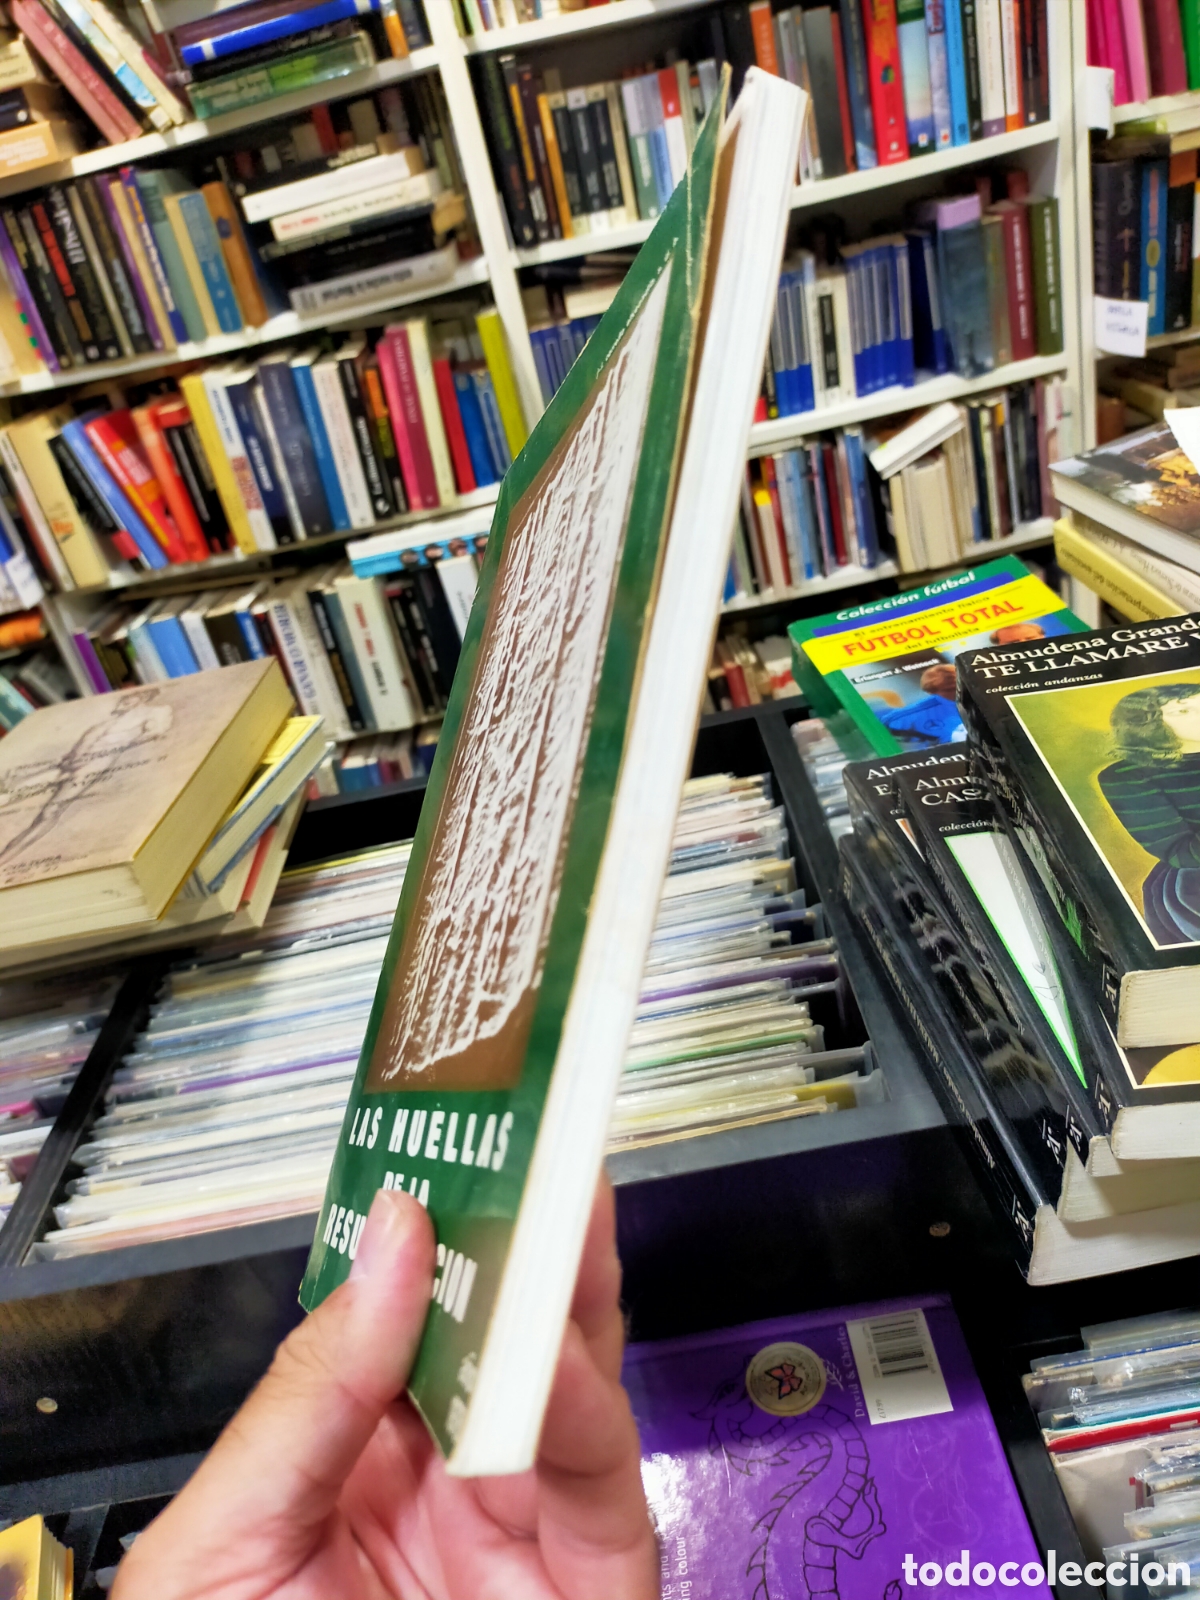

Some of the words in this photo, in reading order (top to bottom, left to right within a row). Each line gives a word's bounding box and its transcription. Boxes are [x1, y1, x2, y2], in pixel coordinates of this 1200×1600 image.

[836, 593, 919, 622] Colección
[924, 571, 976, 597] fútbol
[870, 607, 955, 634] entrenamiento
[941, 600, 1024, 629] TOTAL
[925, 627, 979, 647] futbolista
[971, 635, 1107, 665] Almudena
[974, 664, 1020, 679] TE
[1025, 637, 1189, 673] LLAMARE
[985, 681, 1039, 694] colección
[1044, 673, 1103, 686] andanzas
[867, 754, 966, 780] Almuden
[348, 1106, 383, 1149] LAS
[388, 1108, 514, 1171] HUELLAS
[963, 1108, 995, 1169] Almudena
[836, 1326, 852, 1367] Charles
[848, 1371, 856, 1382] &
[849, 1384, 865, 1418] David
[660, 1555, 670, 1579] and
[674, 1536, 688, 1575] colour
